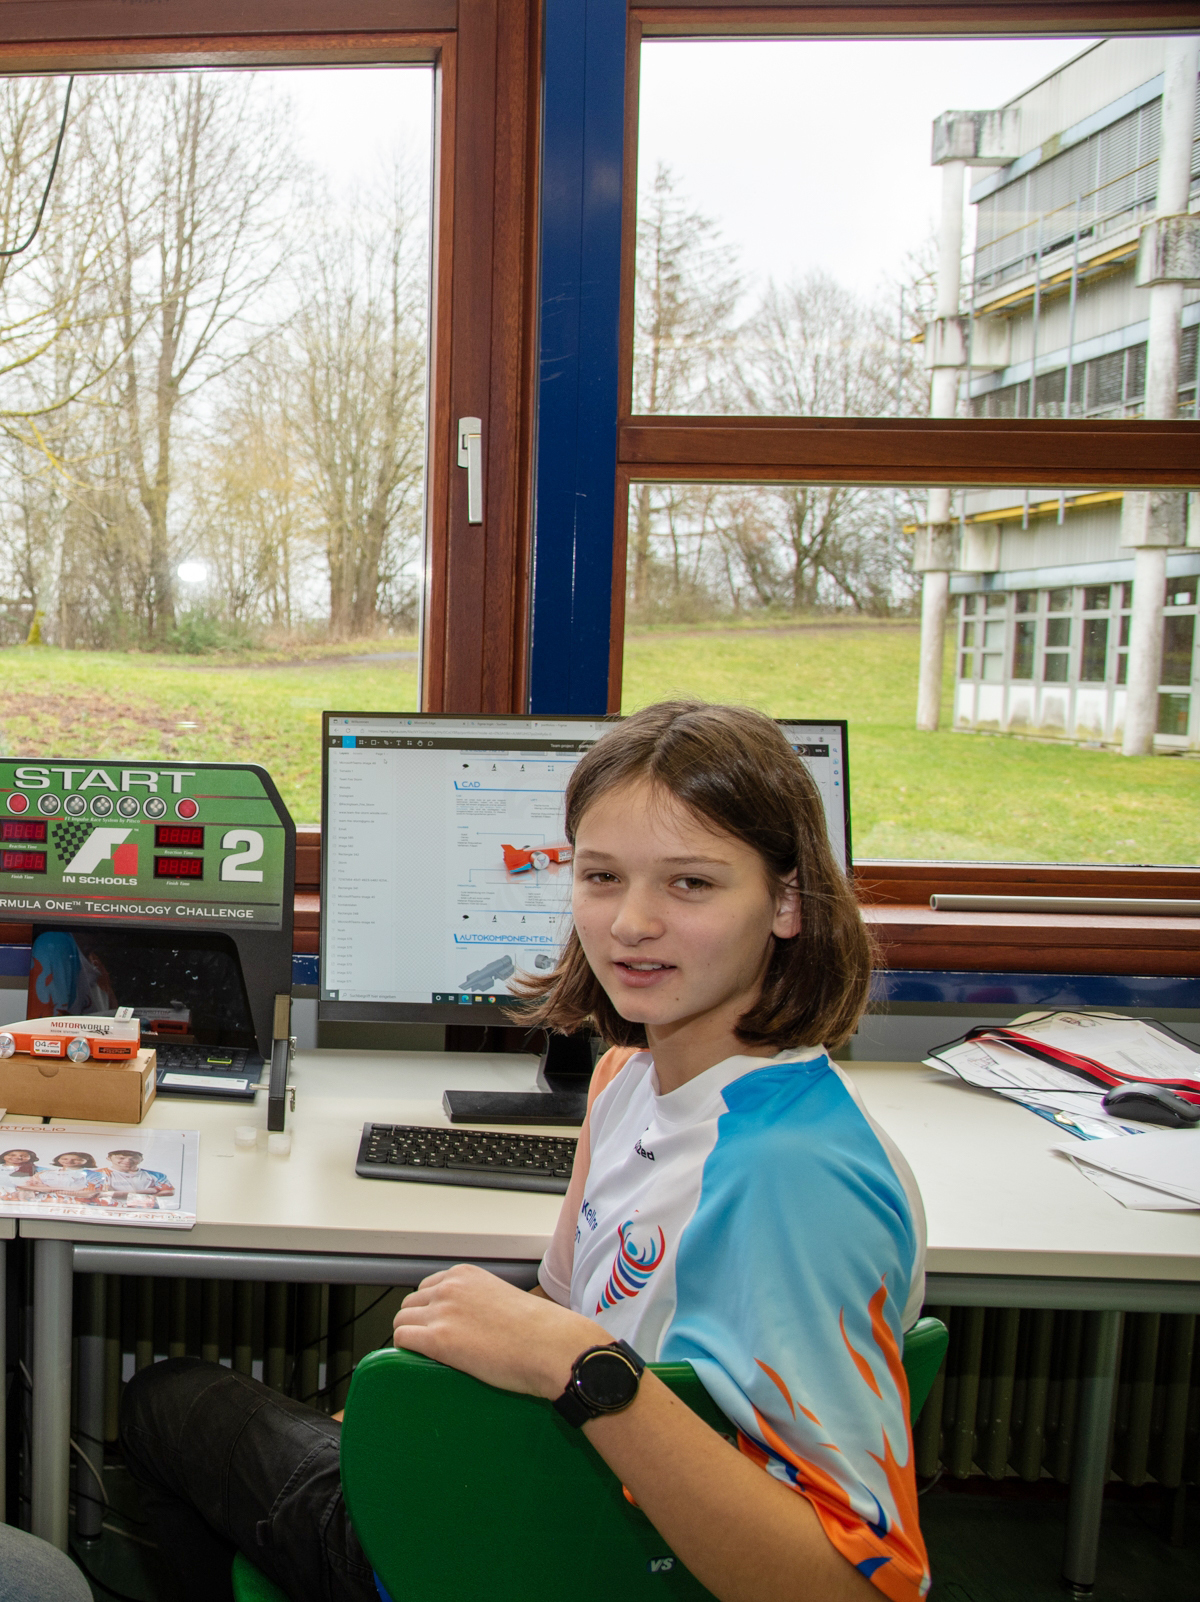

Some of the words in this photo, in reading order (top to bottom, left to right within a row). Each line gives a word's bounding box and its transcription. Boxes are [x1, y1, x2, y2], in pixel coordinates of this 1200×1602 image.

[14, 767, 196, 793] START
[220, 829, 264, 882] 2
[78, 877, 138, 886] SCHOOLS
[85, 901, 171, 915] TECHNOLOGY
[175, 905, 254, 918] CHALLENGE
[459, 934, 553, 943] AUTOKOMPONENTEN
[50, 1021, 110, 1031] MOTORWORLD
[651, 1557, 674, 1572] VS
